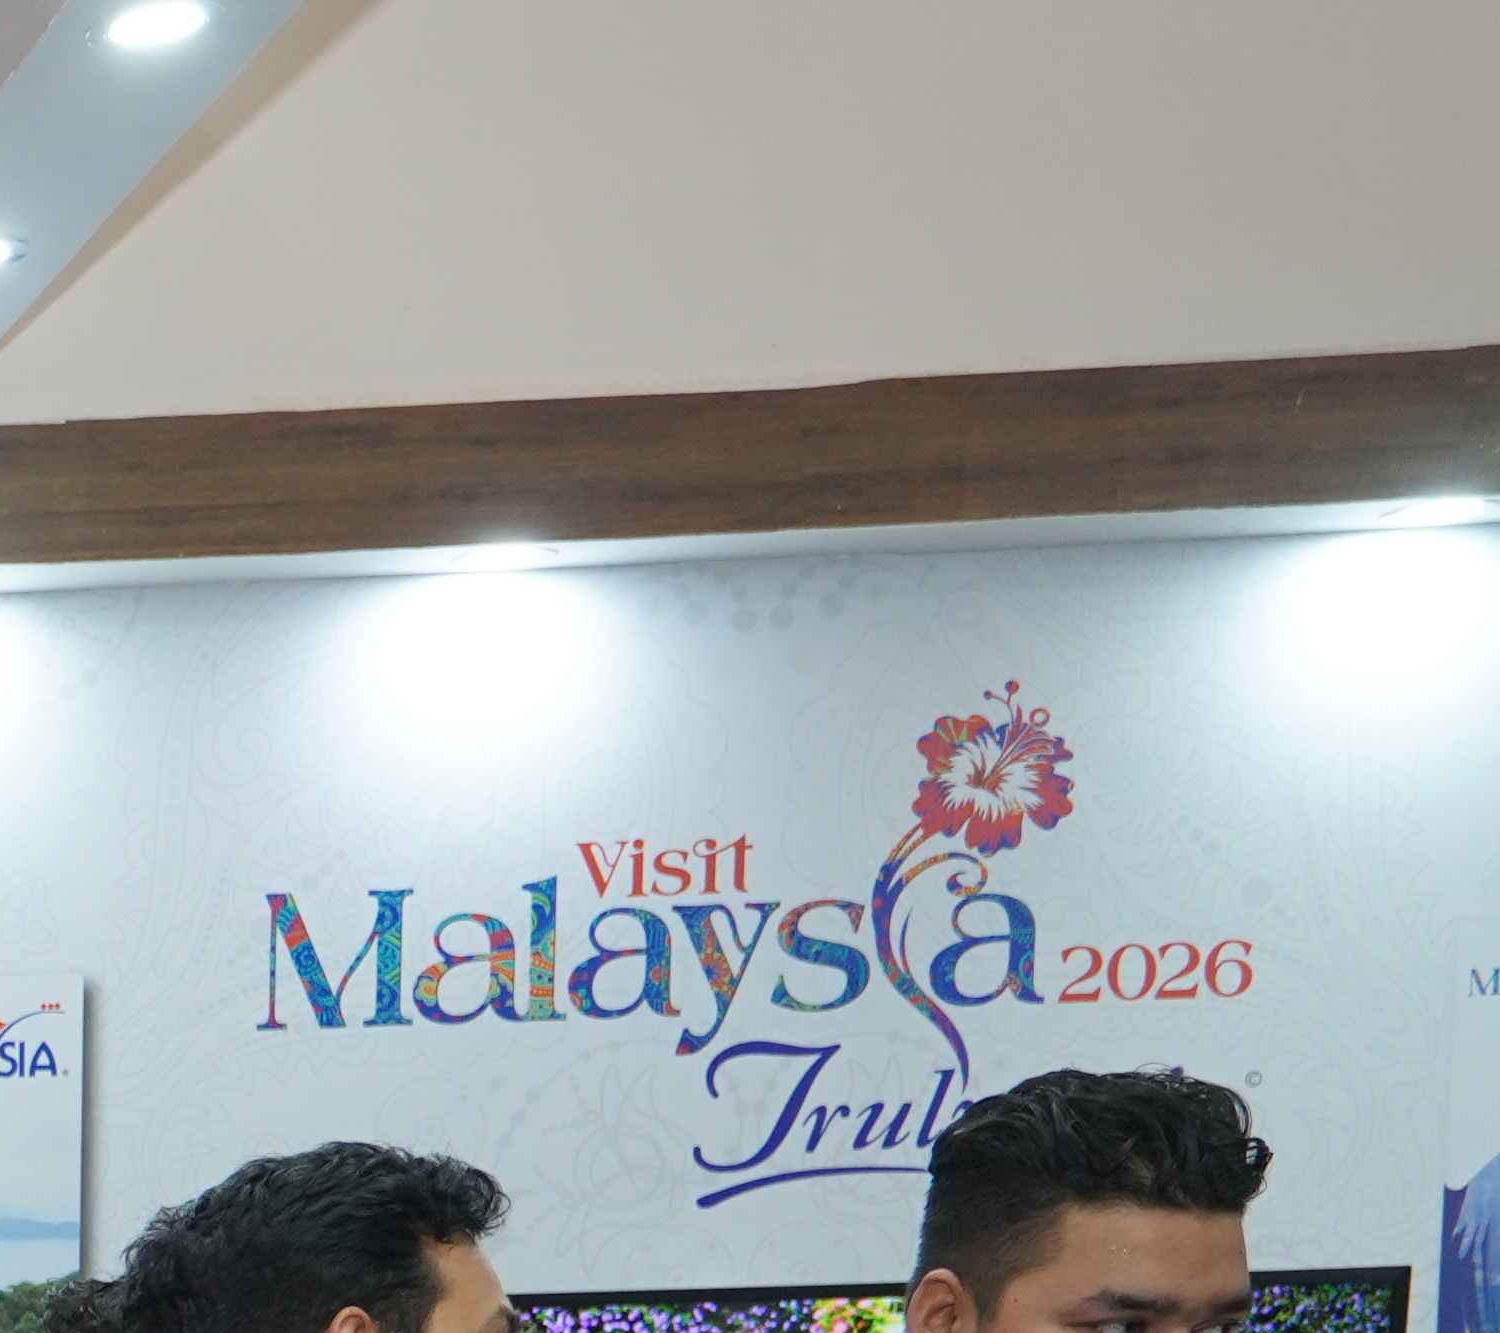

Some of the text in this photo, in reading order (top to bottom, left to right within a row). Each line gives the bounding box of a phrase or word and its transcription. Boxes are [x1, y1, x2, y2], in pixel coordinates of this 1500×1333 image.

[575, 832, 754, 899] Visit
[256, 862, 1254, 1056] Malaysia 2026
[692, 1040, 982, 1174] Trul
